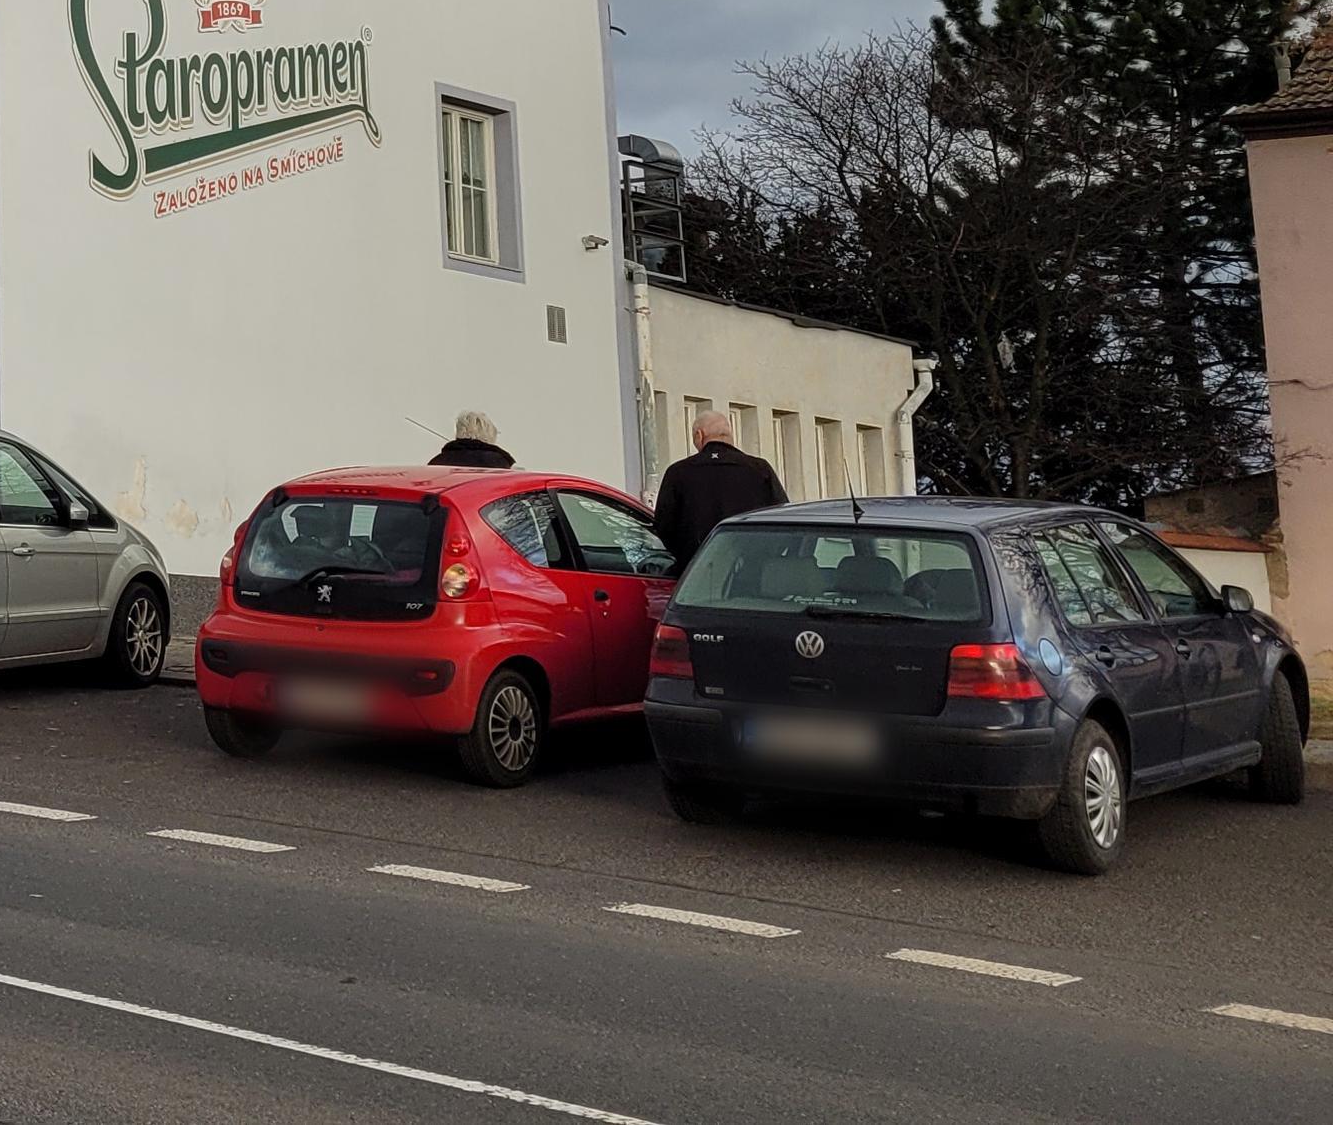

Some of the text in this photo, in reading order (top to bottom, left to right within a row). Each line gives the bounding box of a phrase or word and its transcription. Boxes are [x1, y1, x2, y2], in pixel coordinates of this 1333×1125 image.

[216, 1, 244, 18] 1869
[155, 136, 344, 216] ZALOŽENO NA SMÍCHOVĚ
[405, 601, 424, 611] 107
[693, 633, 725, 643] GOLF
